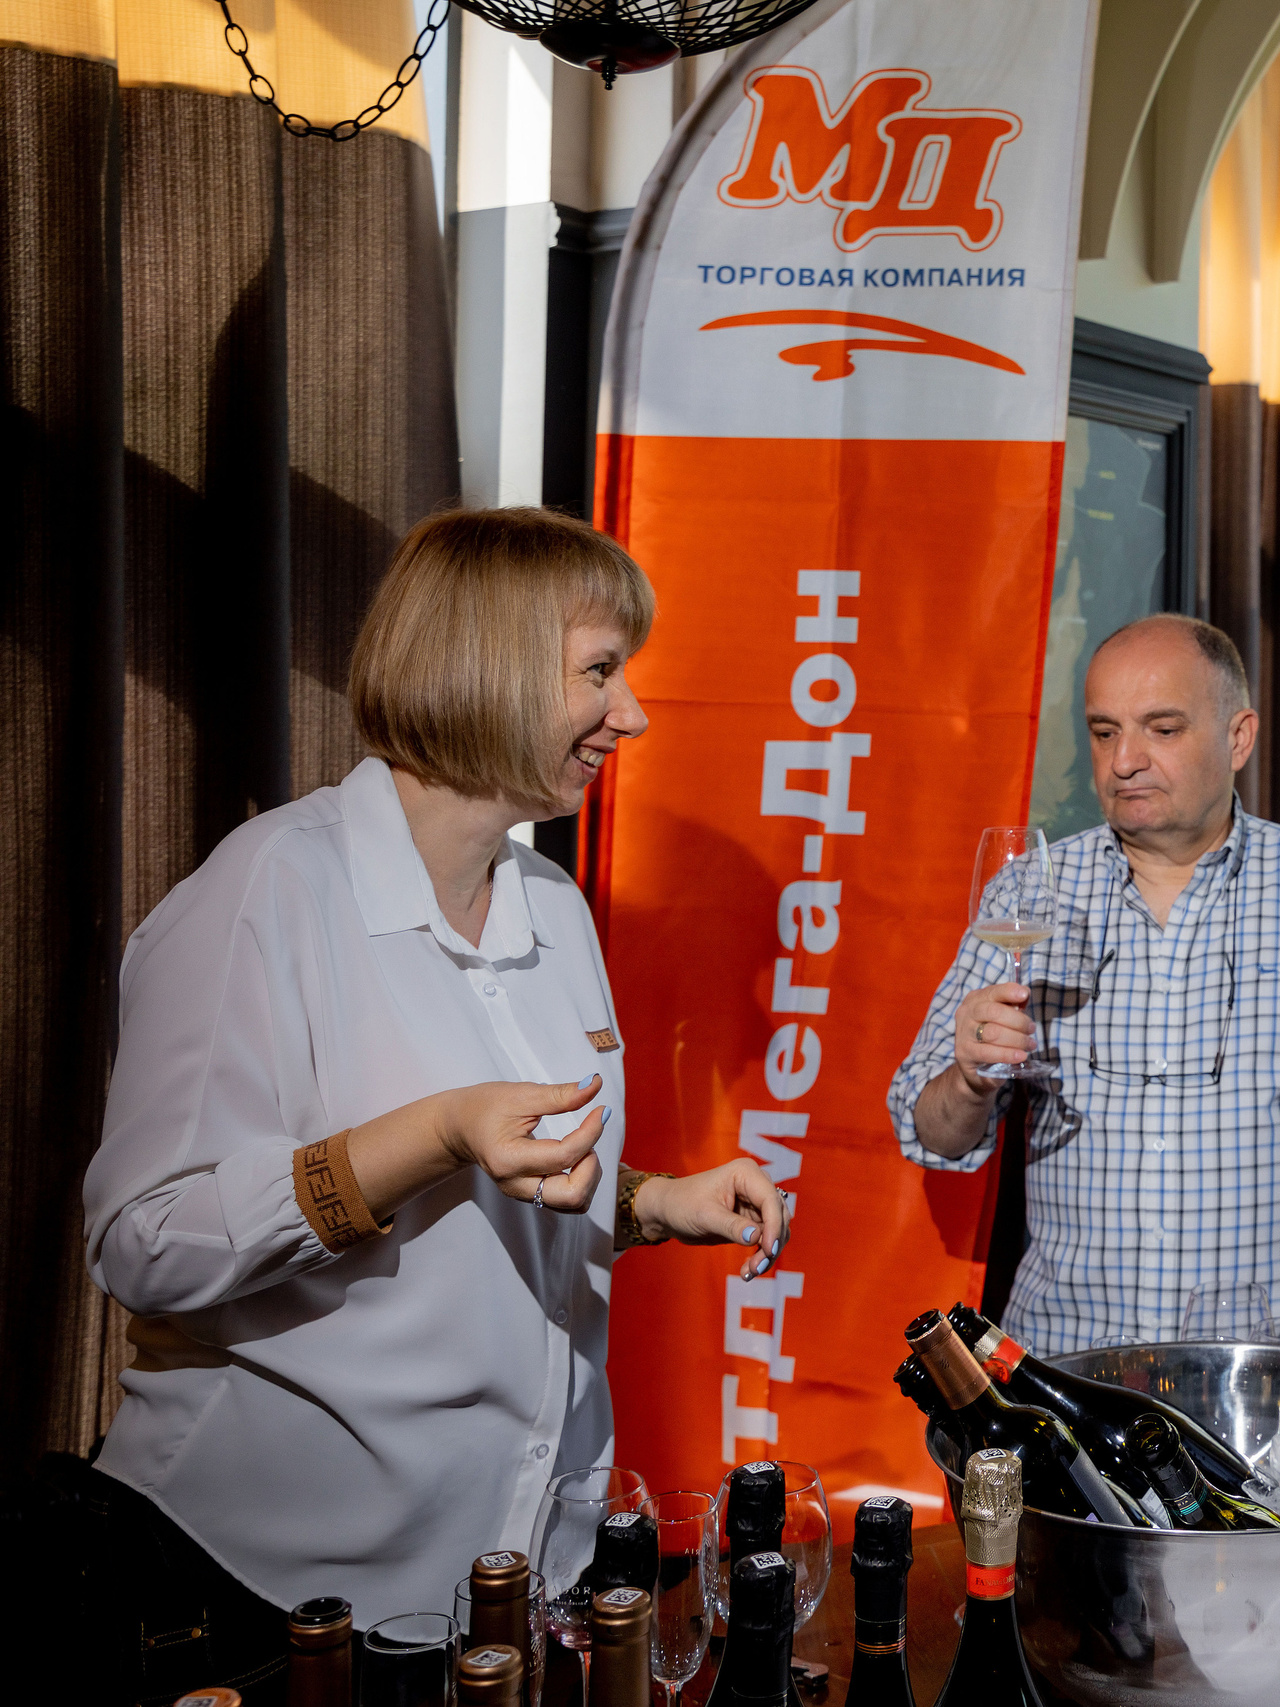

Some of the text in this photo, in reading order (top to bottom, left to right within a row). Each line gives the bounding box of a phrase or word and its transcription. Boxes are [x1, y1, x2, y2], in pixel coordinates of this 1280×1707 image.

[717, 65, 1022, 253] МД
[697, 264, 1026, 289] ТОРГОВАЯ КОМПАНИЯ
